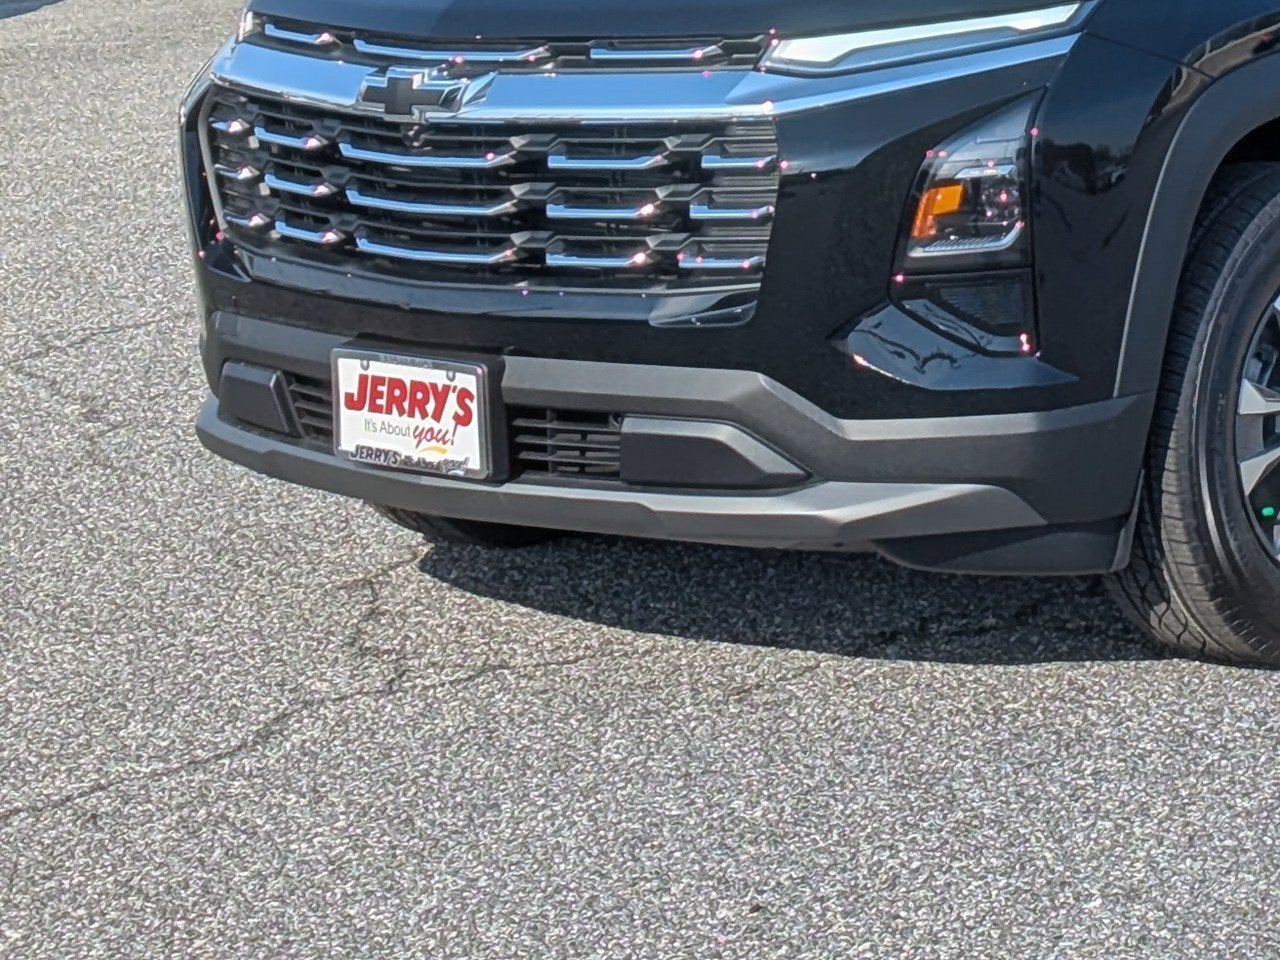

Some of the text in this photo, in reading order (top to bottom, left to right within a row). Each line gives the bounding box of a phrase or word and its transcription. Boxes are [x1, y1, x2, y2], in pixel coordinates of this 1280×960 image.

[344, 373, 475, 427] JERRY'S
[364, 418, 458, 450] It's About you!
